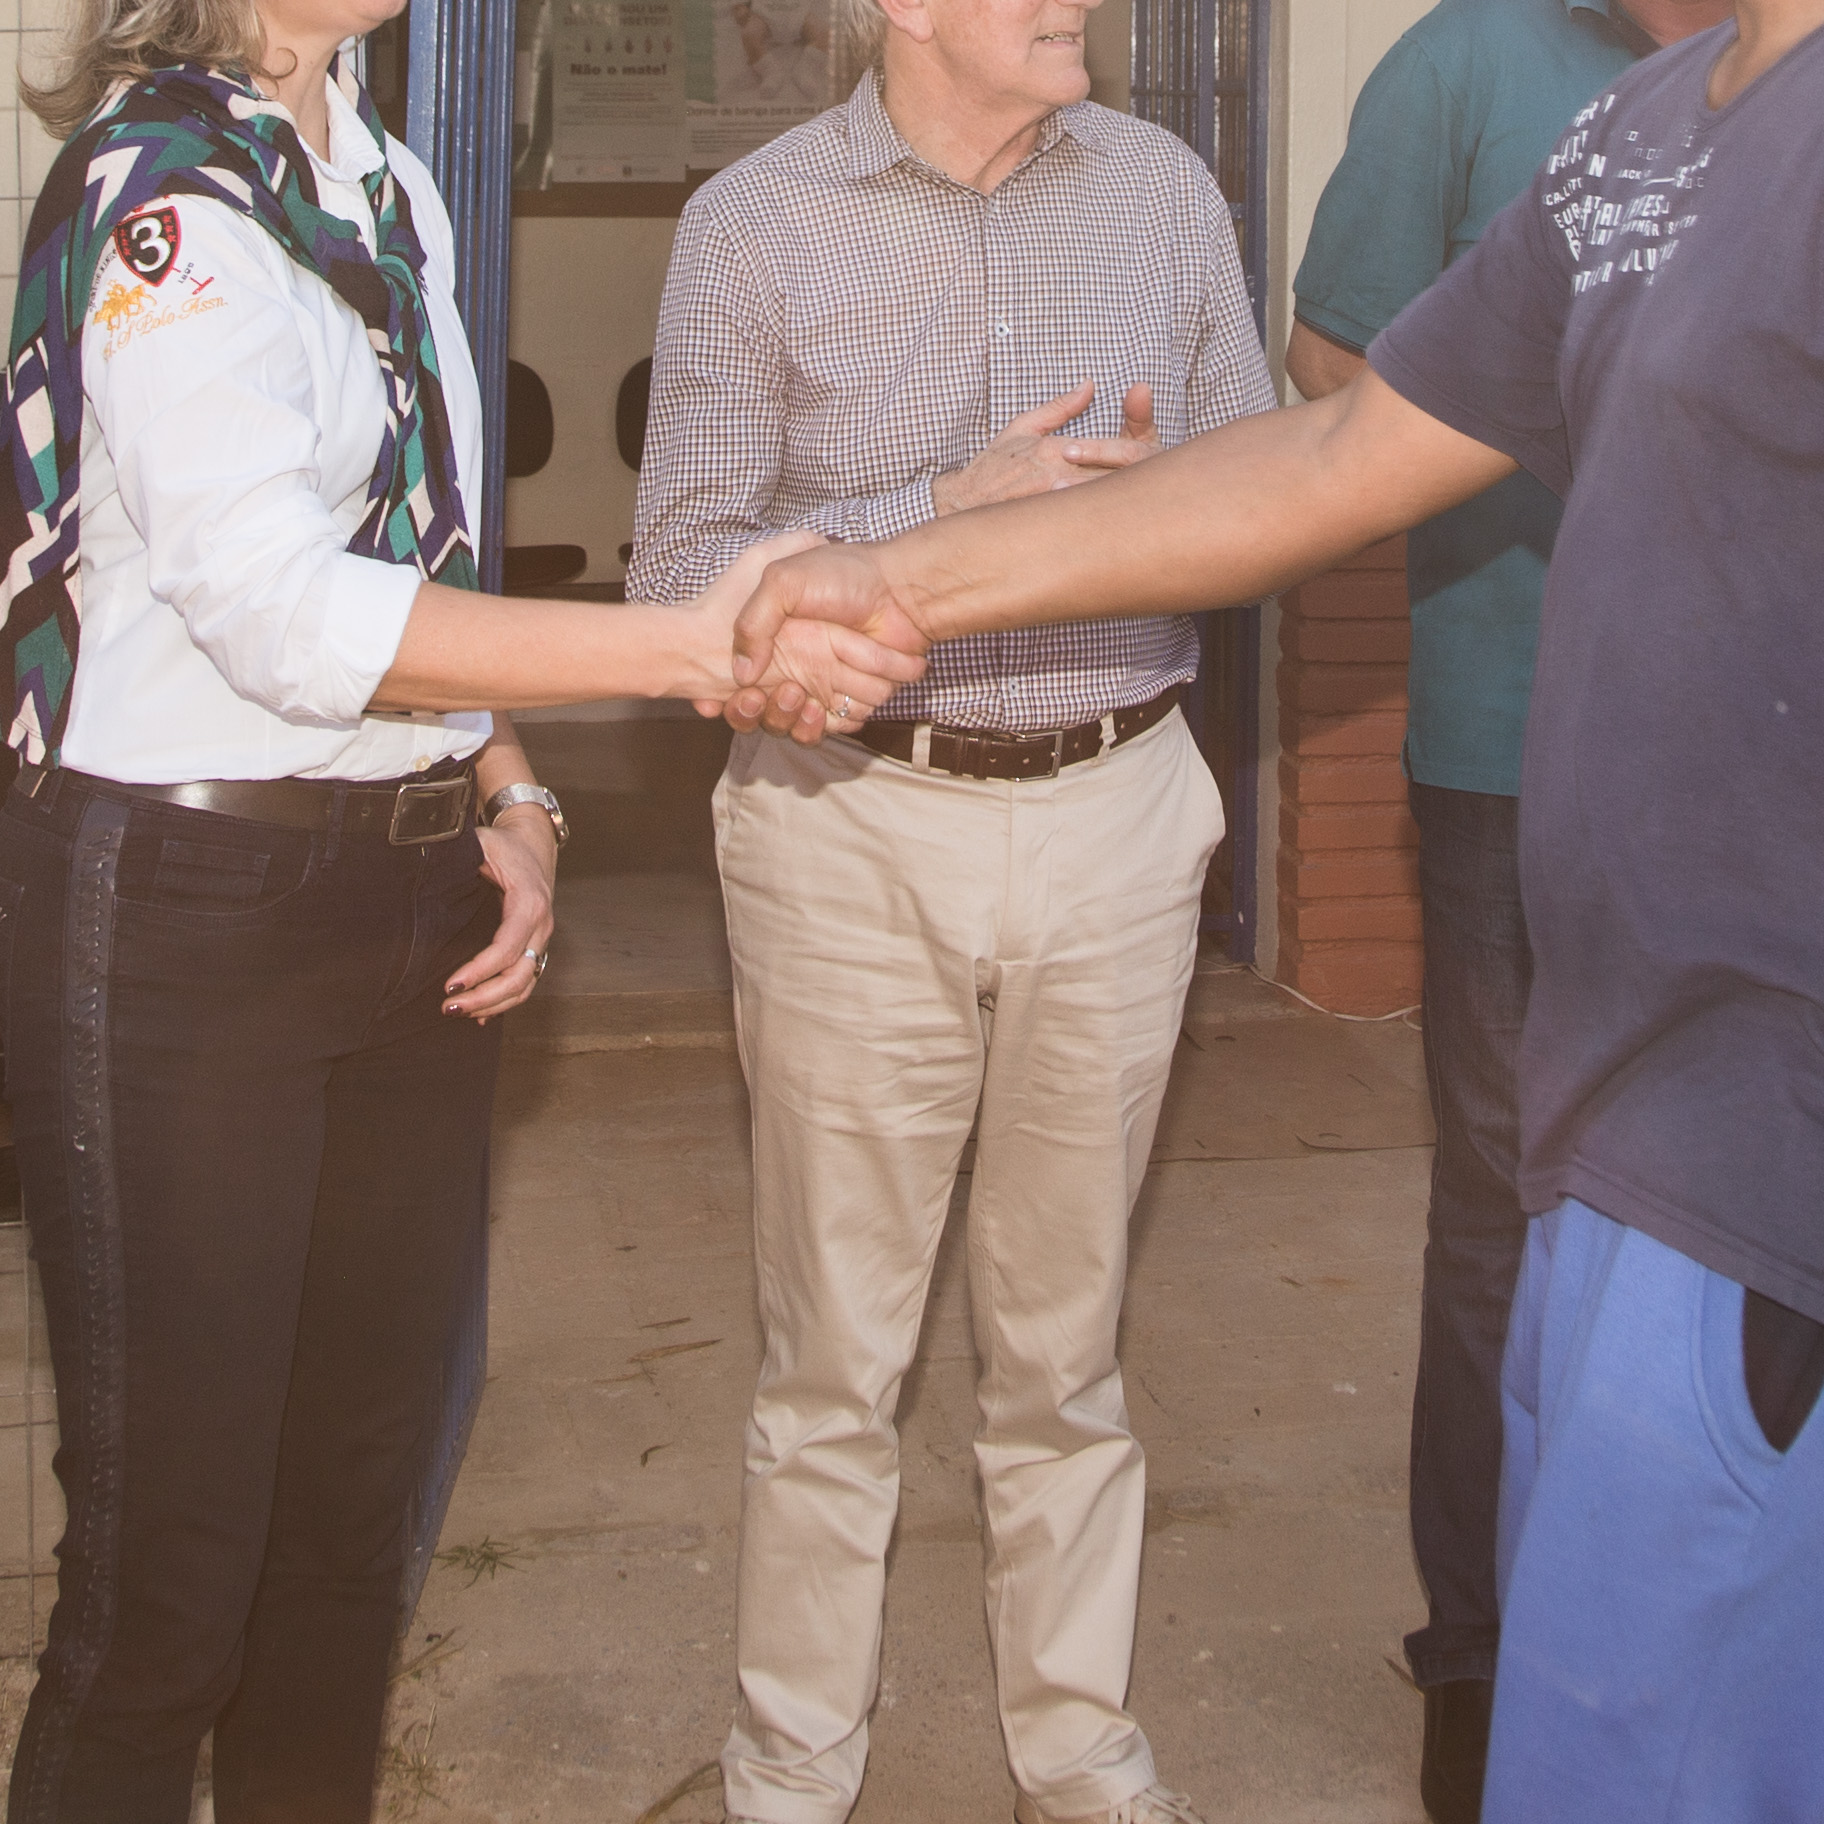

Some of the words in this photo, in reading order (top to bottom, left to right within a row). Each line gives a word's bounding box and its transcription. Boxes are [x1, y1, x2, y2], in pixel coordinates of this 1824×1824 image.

[570, 63, 602, 75] Não
[607, 65, 617, 75] o
[622, 63, 667, 75] mate!
[131, 216, 171, 273] 3
